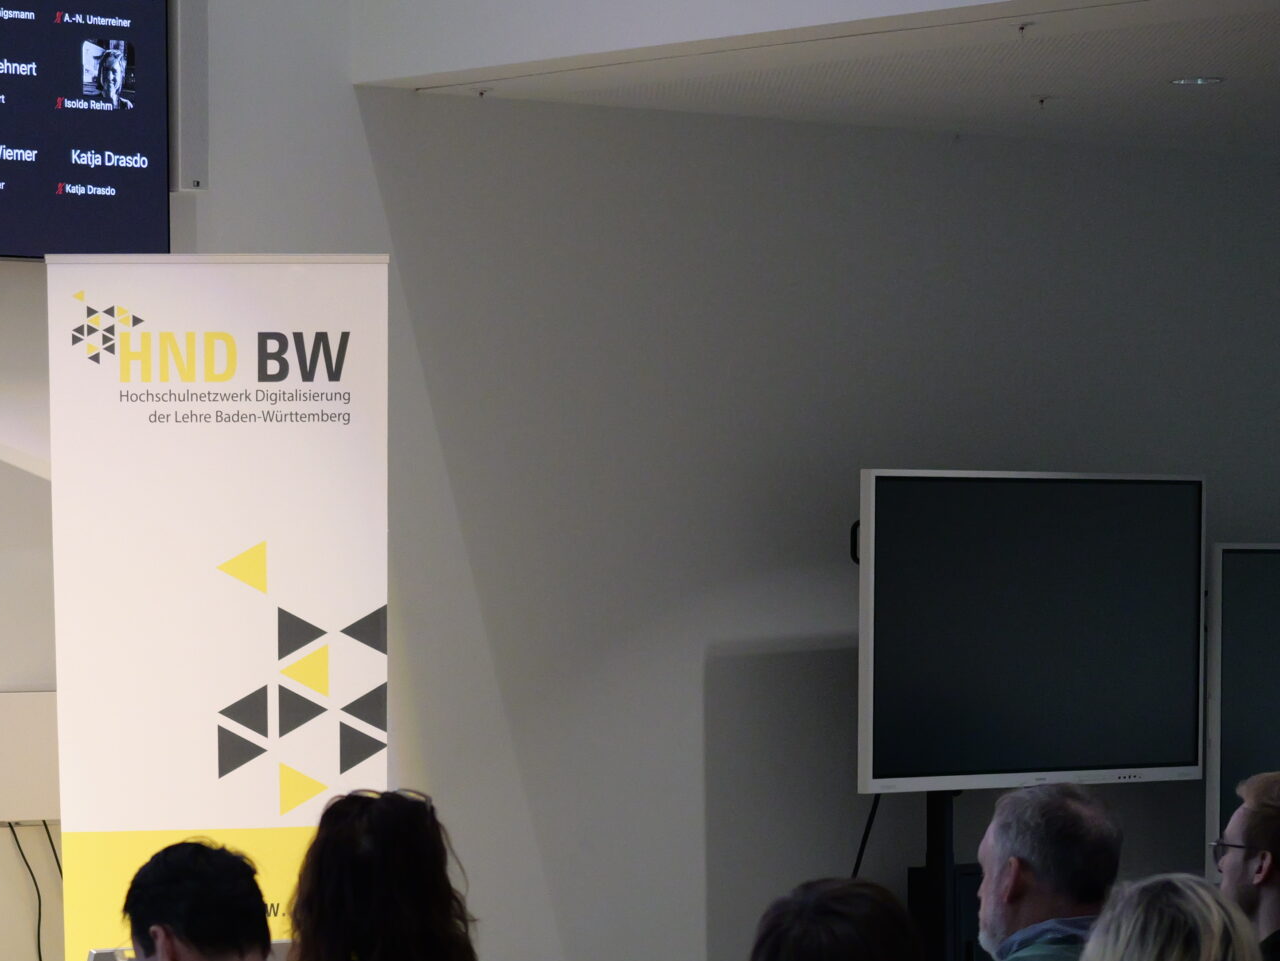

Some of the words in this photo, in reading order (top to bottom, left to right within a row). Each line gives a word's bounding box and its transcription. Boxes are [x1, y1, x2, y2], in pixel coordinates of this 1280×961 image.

[63, 13, 85, 24] A.-N.
[86, 15, 132, 28] Unterreiner
[64, 98, 89, 109] Isolde
[90, 100, 113, 111] Rehm
[71, 149, 102, 169] Katja
[104, 150, 149, 168] Drasdo
[65, 183, 86, 196] Katja
[87, 185, 117, 196] Drasdo
[118, 331, 238, 383] HND
[256, 331, 351, 383] BW
[118, 388, 252, 403] Hochschulnetzwerk
[254, 388, 352, 406] Digitalisierung
[148, 410, 172, 424] der
[174, 410, 212, 424] Lehre
[214, 409, 351, 426] Baden-Württemberg
